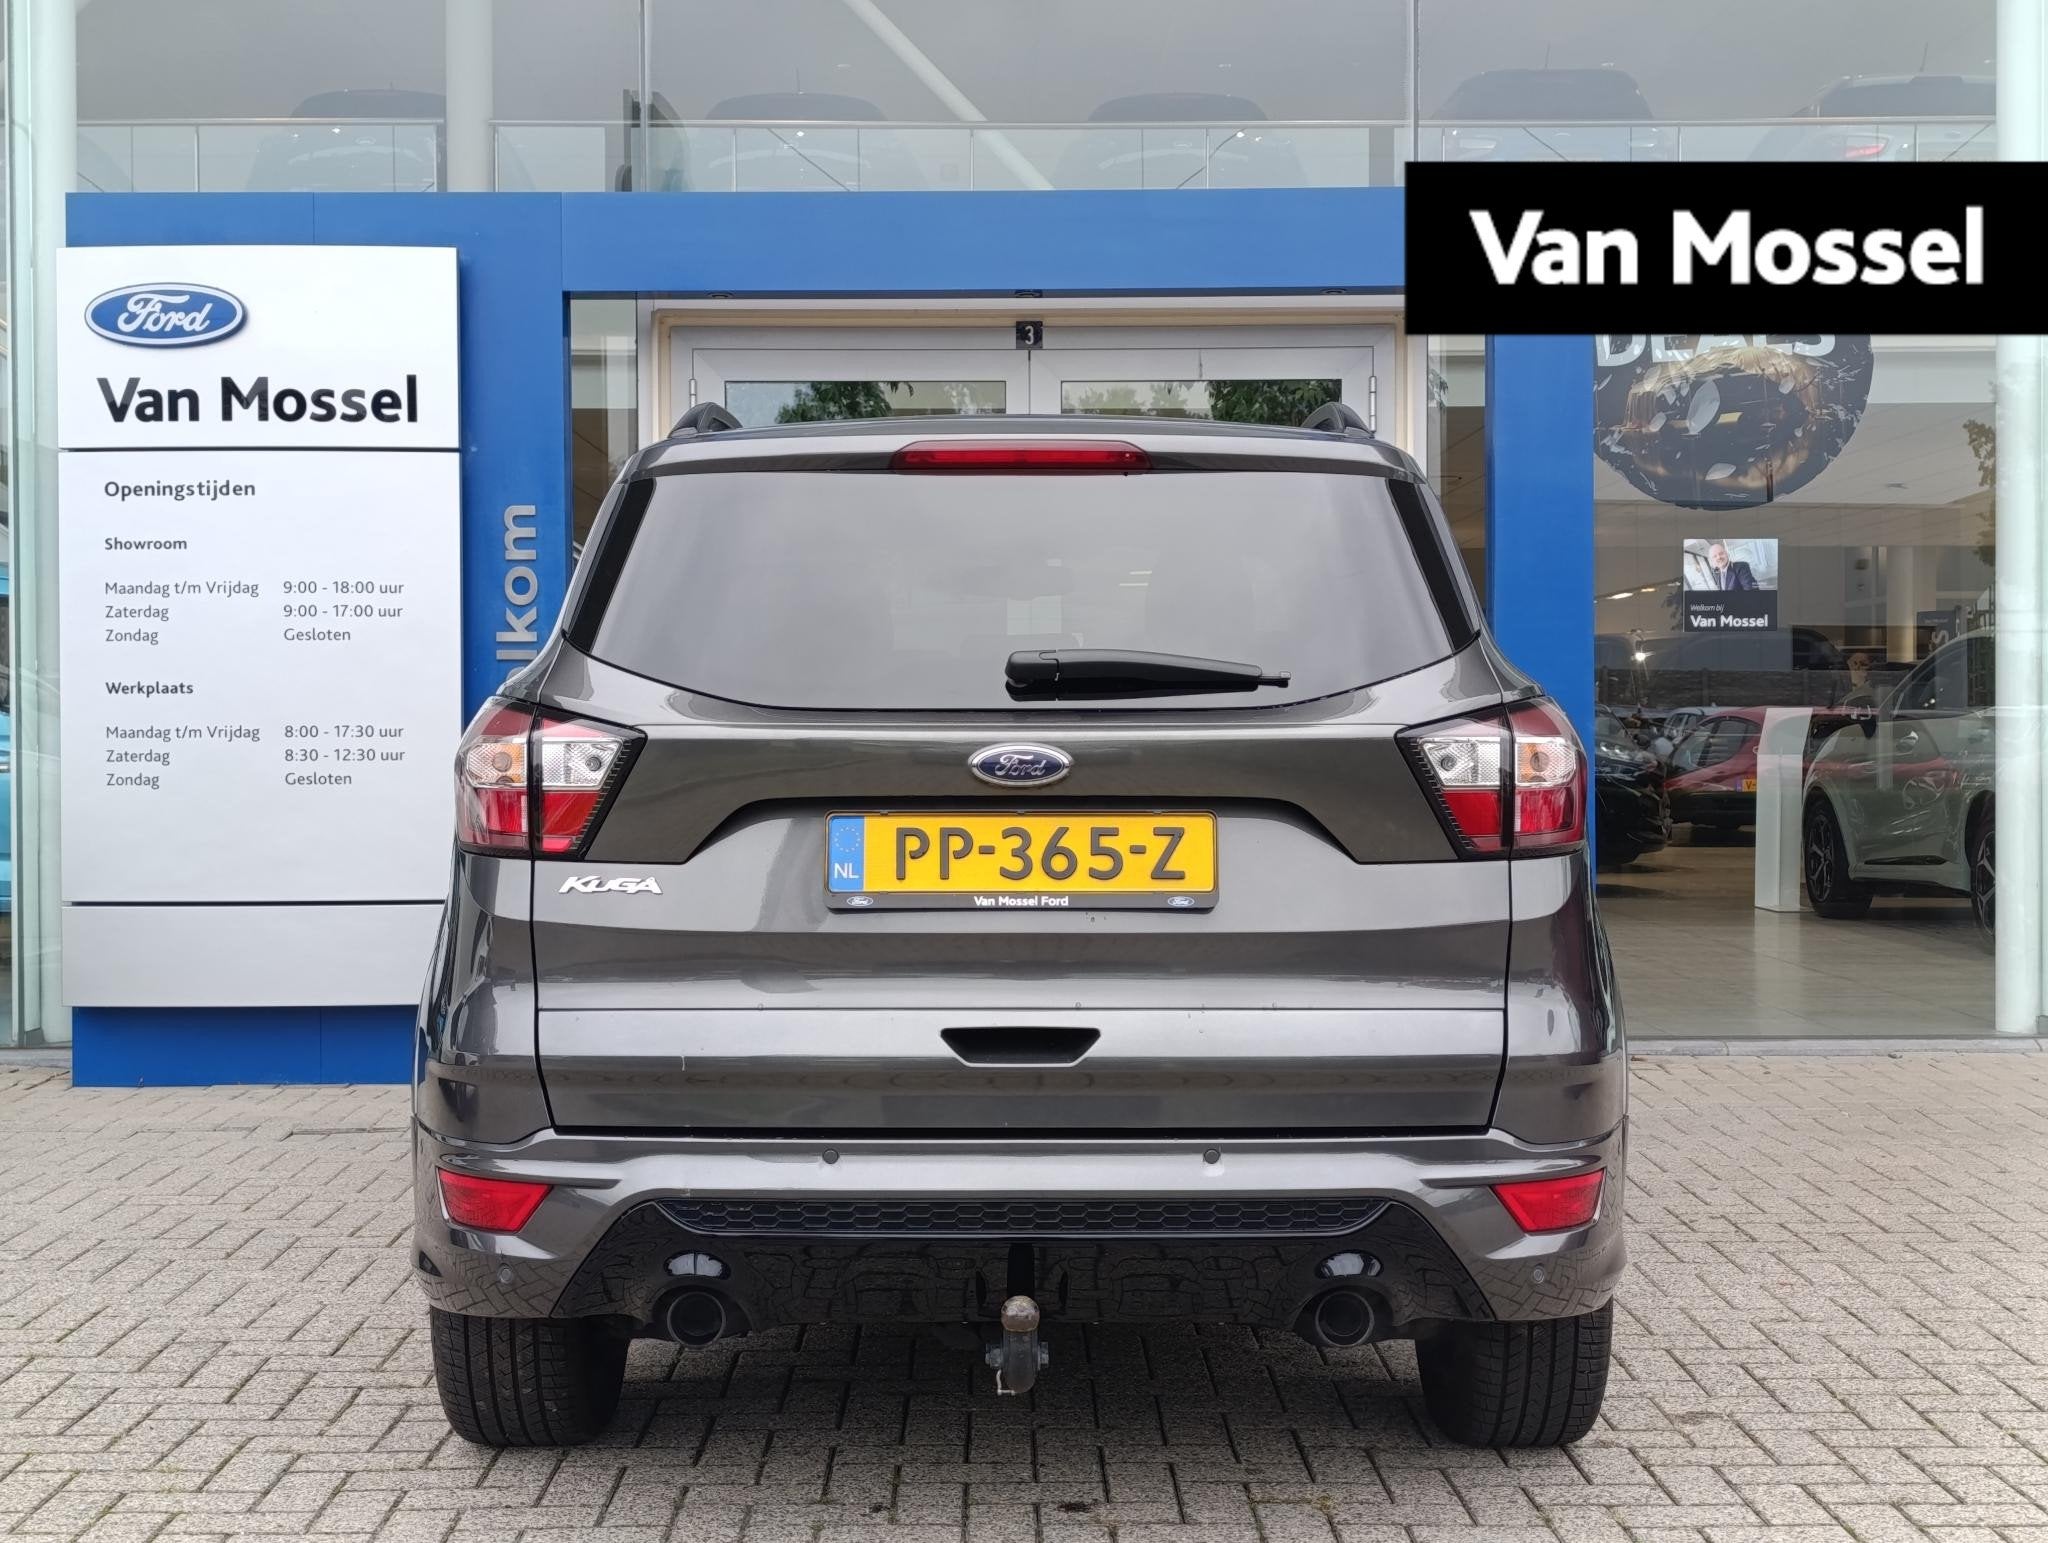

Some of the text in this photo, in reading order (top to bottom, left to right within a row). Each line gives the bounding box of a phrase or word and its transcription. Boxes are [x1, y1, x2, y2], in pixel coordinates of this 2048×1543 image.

[117, 293, 213, 332] Ford
[1025, 325, 1034, 345] 3
[97, 375, 417, 423] Van Mossel
[104, 480, 256, 501] Openingstijden
[104, 537, 187, 550] Showroom
[105, 580, 259, 598] Maandag t/m Vrijdag
[283, 580, 317, 594] 9:00
[333, 580, 374, 594] 18:00
[379, 584, 404, 594] uur
[105, 604, 169, 621] Zaterdag
[283, 604, 317, 618] 9:00
[333, 604, 373, 618] 17:00
[379, 607, 403, 617] uur
[1690, 614, 1769, 628] Van Mossel
[106, 628, 158, 645] Zondag
[284, 628, 351, 641] Gesloten
[105, 681, 194, 698] Werkplaats
[106, 725, 260, 742] Maandag t/m Vrijdag
[284, 725, 318, 738] 8:00
[334, 725, 374, 738] 17:30
[380, 728, 404, 738] uur
[106, 749, 170, 766] Zaterdag
[284, 749, 318, 762] 8:30
[334, 749, 375, 762] 12:30
[380, 752, 405, 762] uur
[995, 754, 1046, 775] Ford
[106, 773, 159, 790] Zondag
[285, 772, 352, 785] Gesloten
[895, 827, 1186, 881] PP-365-Z
[834, 863, 859, 879] NL
[559, 876, 663, 895] KUGA
[974, 896, 1069, 906] Van Mossel Ford
